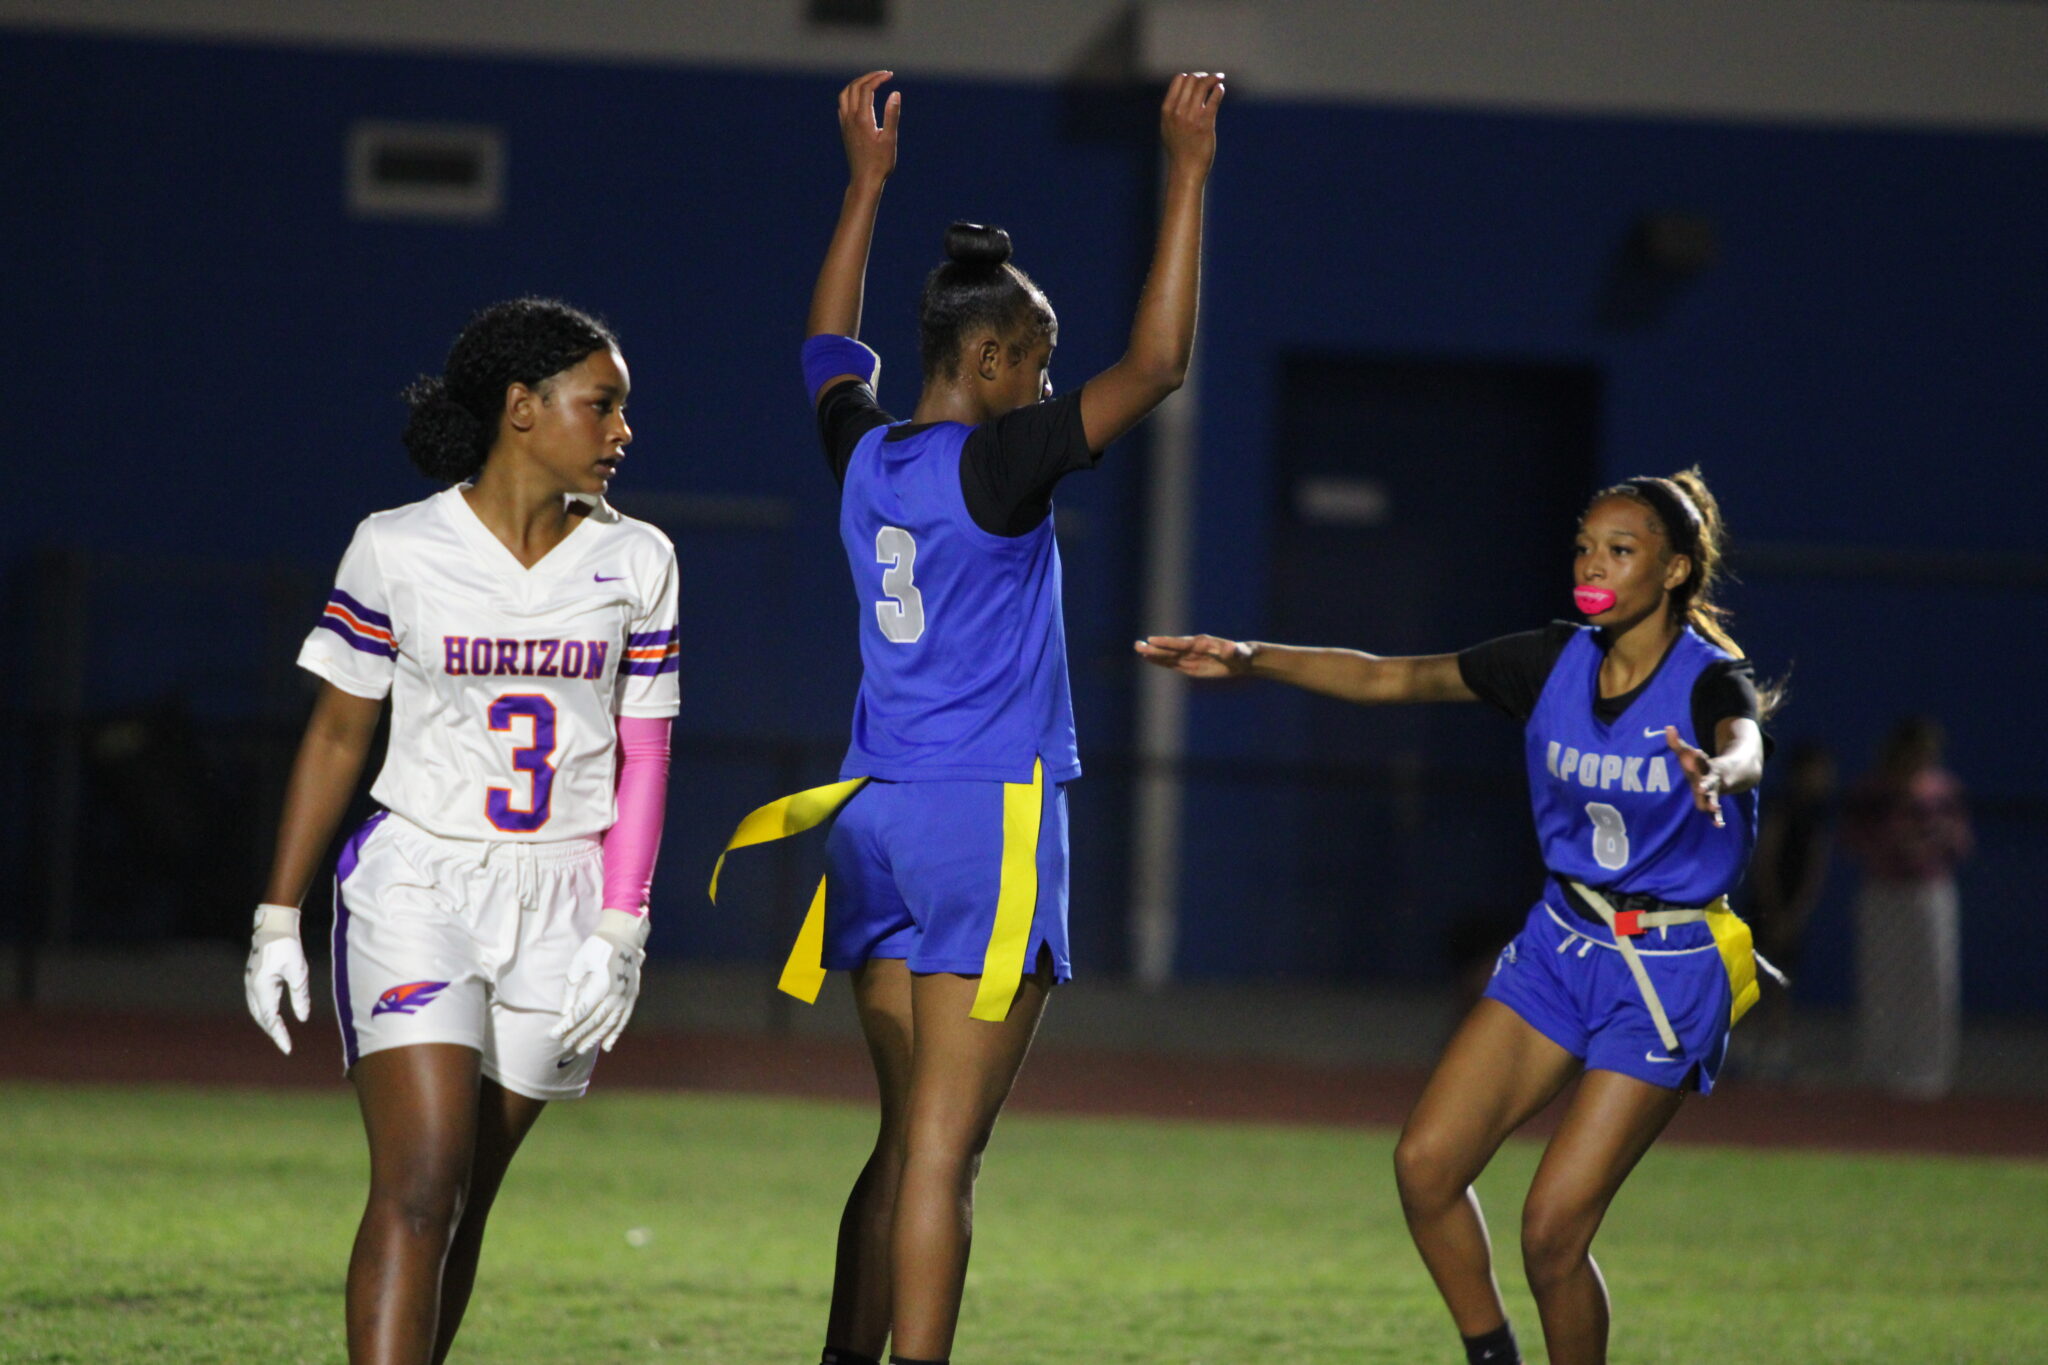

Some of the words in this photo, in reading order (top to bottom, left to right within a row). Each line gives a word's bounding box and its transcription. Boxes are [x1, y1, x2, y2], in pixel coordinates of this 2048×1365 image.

[875, 526, 925, 643] 3
[443, 635, 609, 680] HORIZON
[484, 693, 557, 833] 3
[1584, 801, 1630, 871] 8
